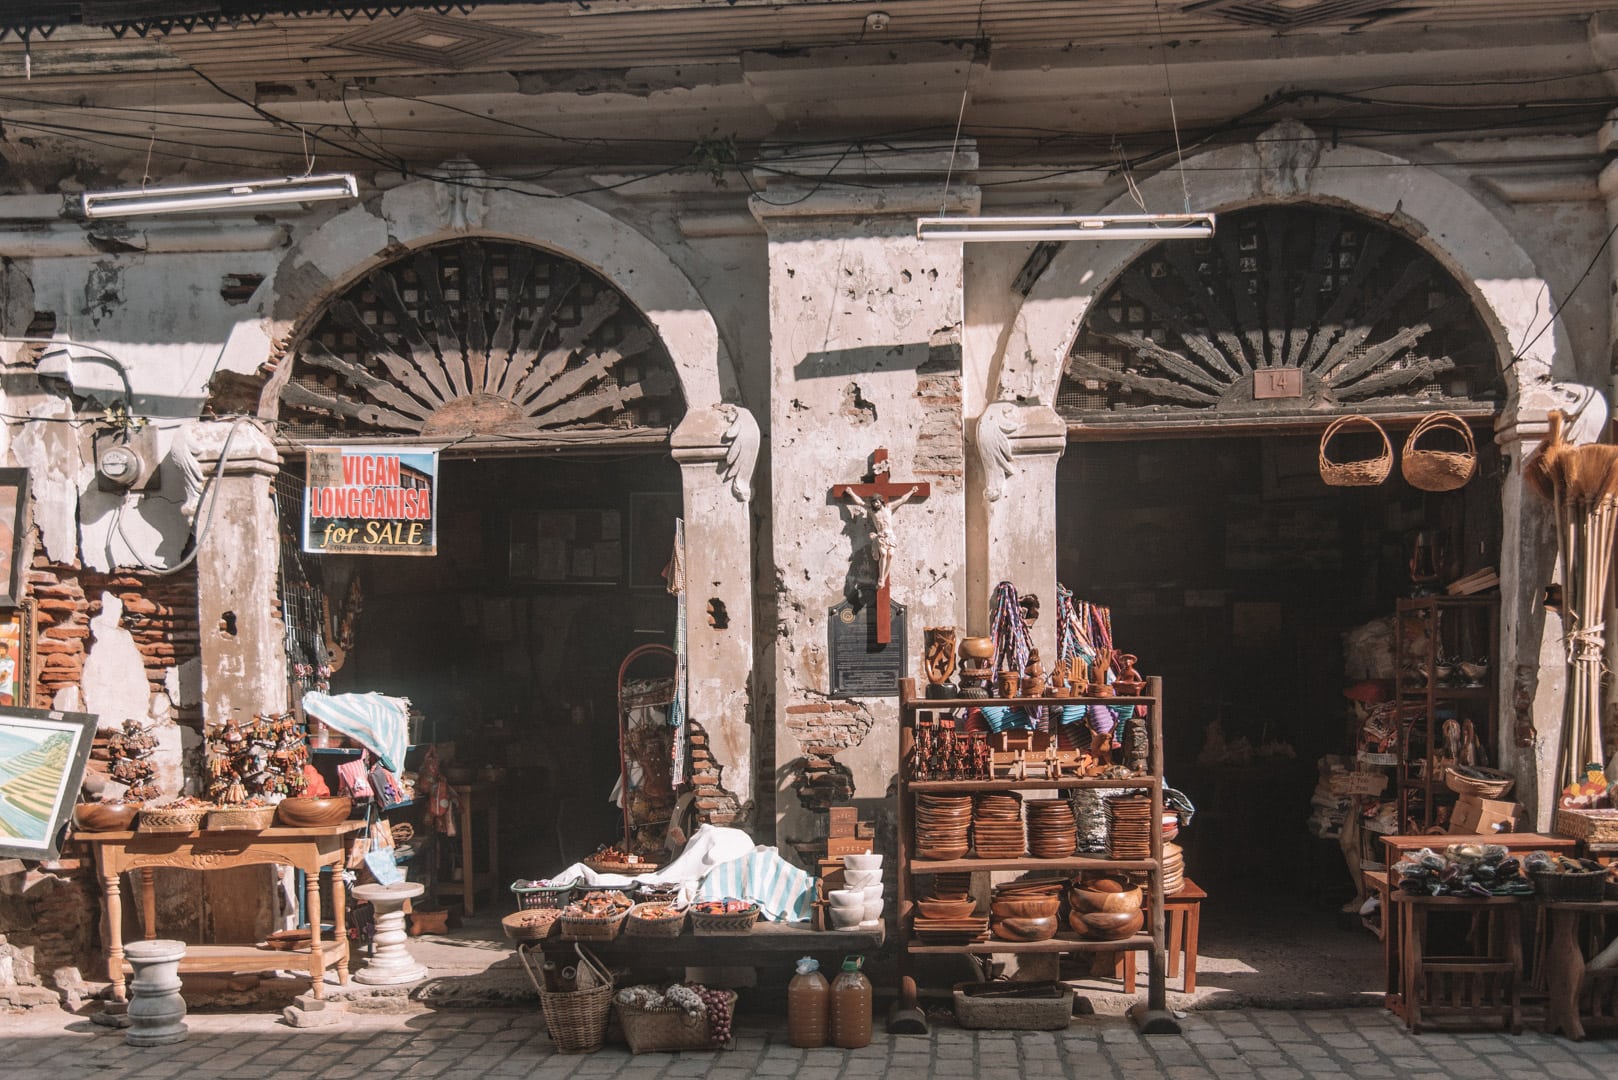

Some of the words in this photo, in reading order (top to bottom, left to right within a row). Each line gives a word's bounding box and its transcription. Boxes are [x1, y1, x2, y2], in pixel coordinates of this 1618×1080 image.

[1269, 372, 1287, 391] 14
[342, 455, 401, 486] VIGAN
[312, 487, 431, 520] LONGGANISA
[320, 523, 359, 548] for
[363, 521, 424, 545] SALE
